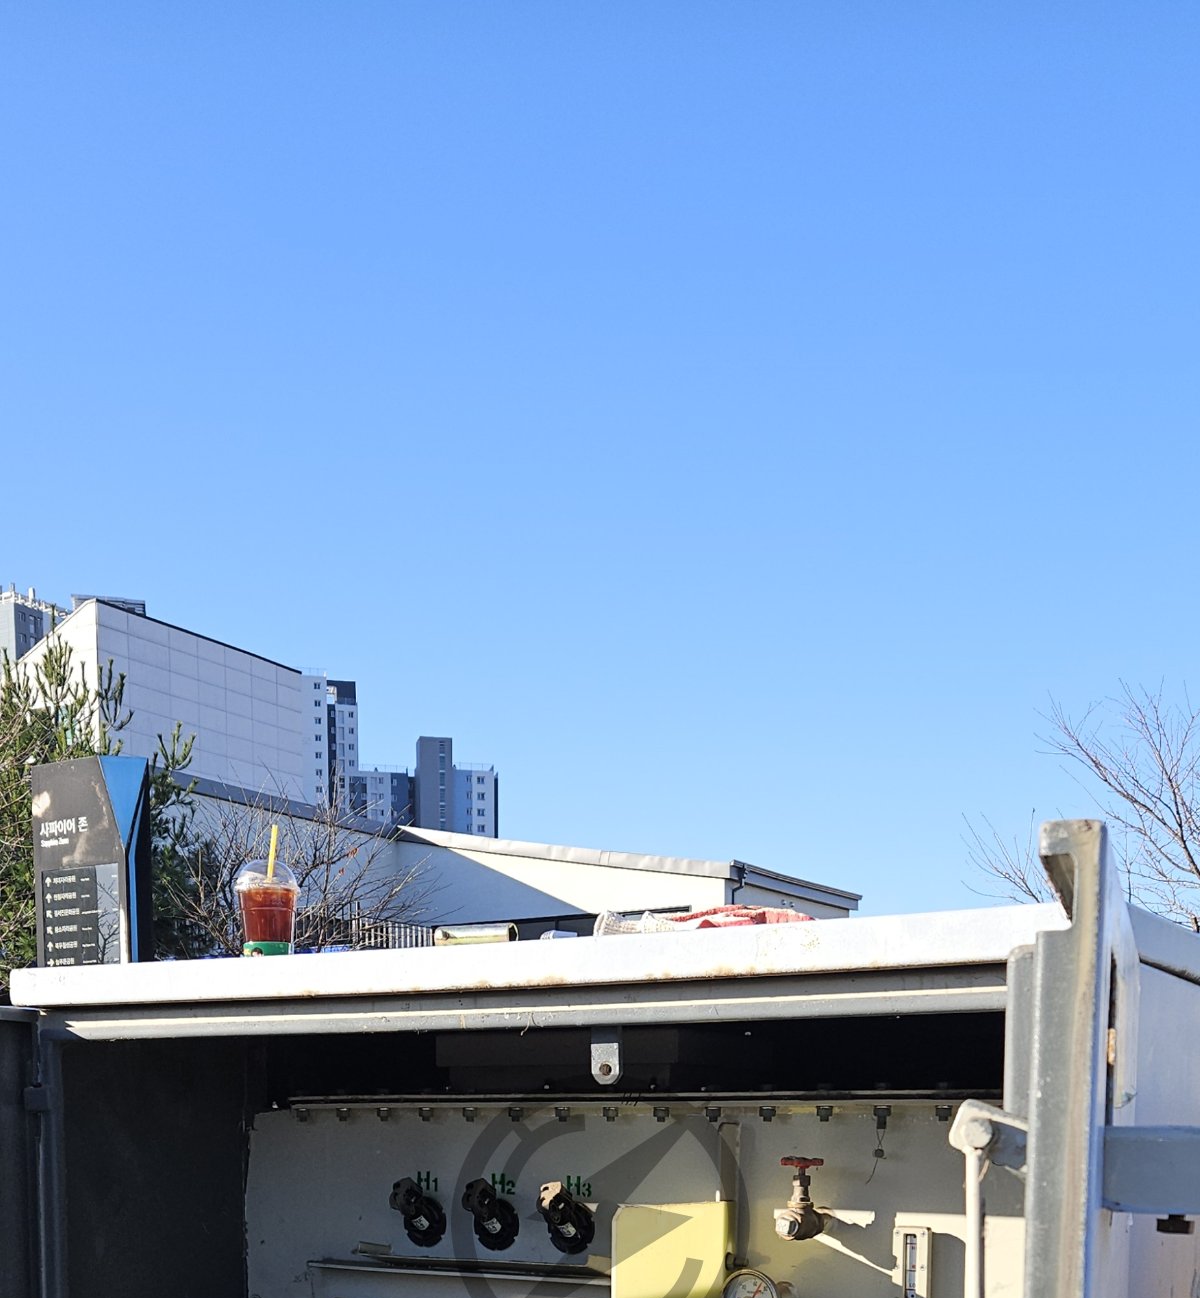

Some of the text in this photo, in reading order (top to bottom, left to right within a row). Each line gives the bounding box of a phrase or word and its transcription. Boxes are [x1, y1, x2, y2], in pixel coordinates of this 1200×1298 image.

[40, 816, 88, 837] 사파이어 존
[491, 1172, 516, 1195] H2
[566, 1175, 592, 1198] H3
